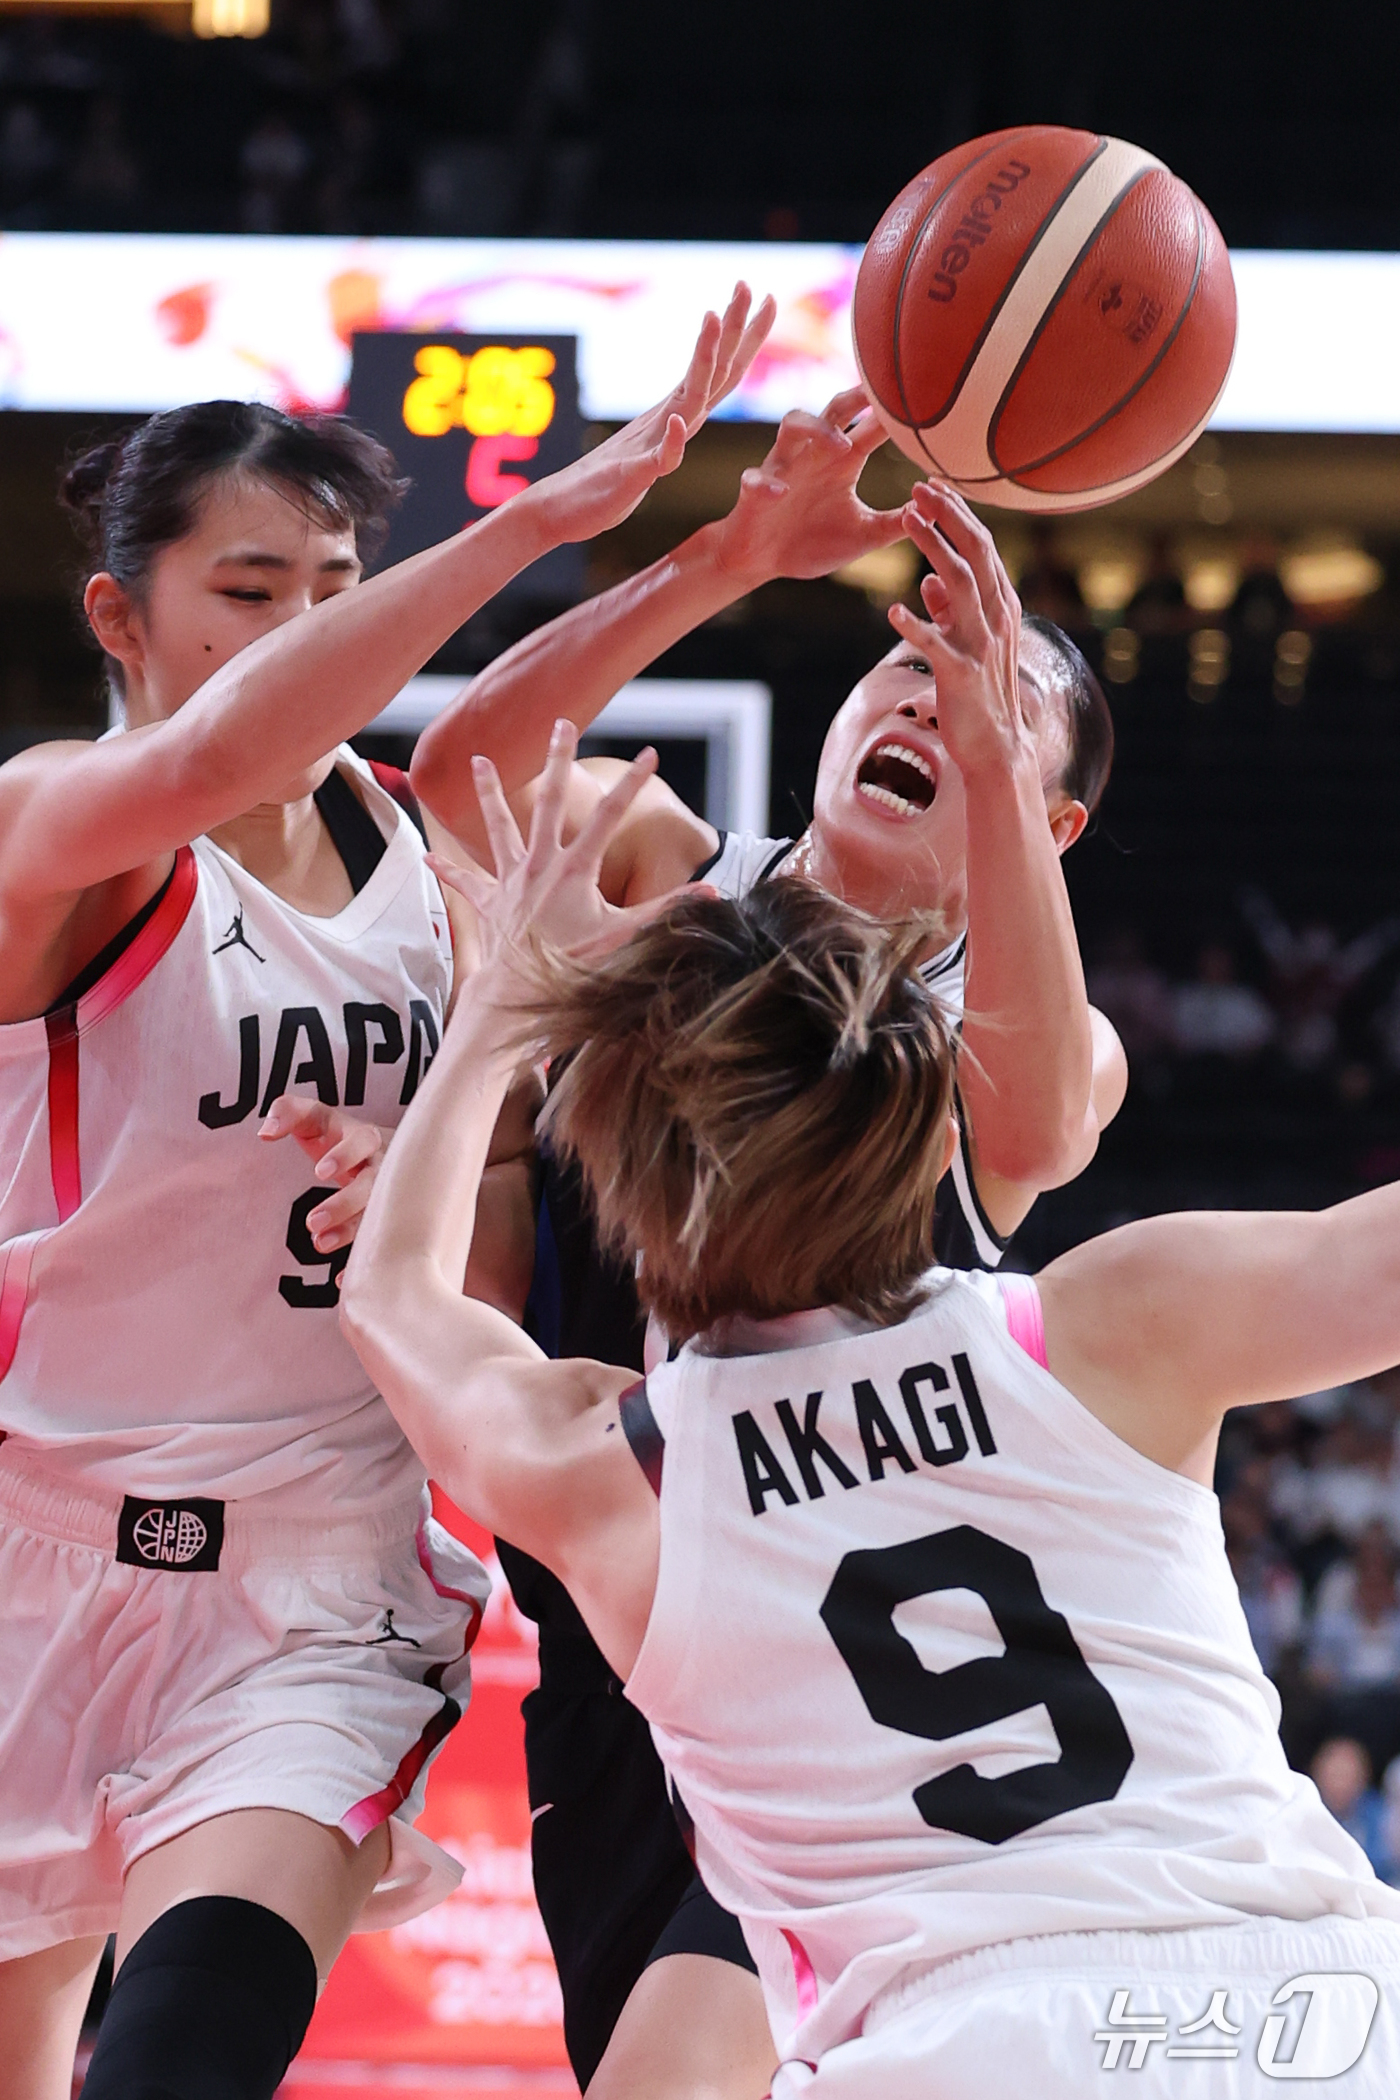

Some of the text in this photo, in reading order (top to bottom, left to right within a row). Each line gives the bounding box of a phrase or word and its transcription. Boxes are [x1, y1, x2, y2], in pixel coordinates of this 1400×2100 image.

[928, 161, 1031, 303] molten
[198, 1000, 440, 1130] JAPA
[731, 1352, 998, 1517] AKAGI
[160, 1510, 178, 1563] JPN
[819, 1524, 1134, 1845] 9
